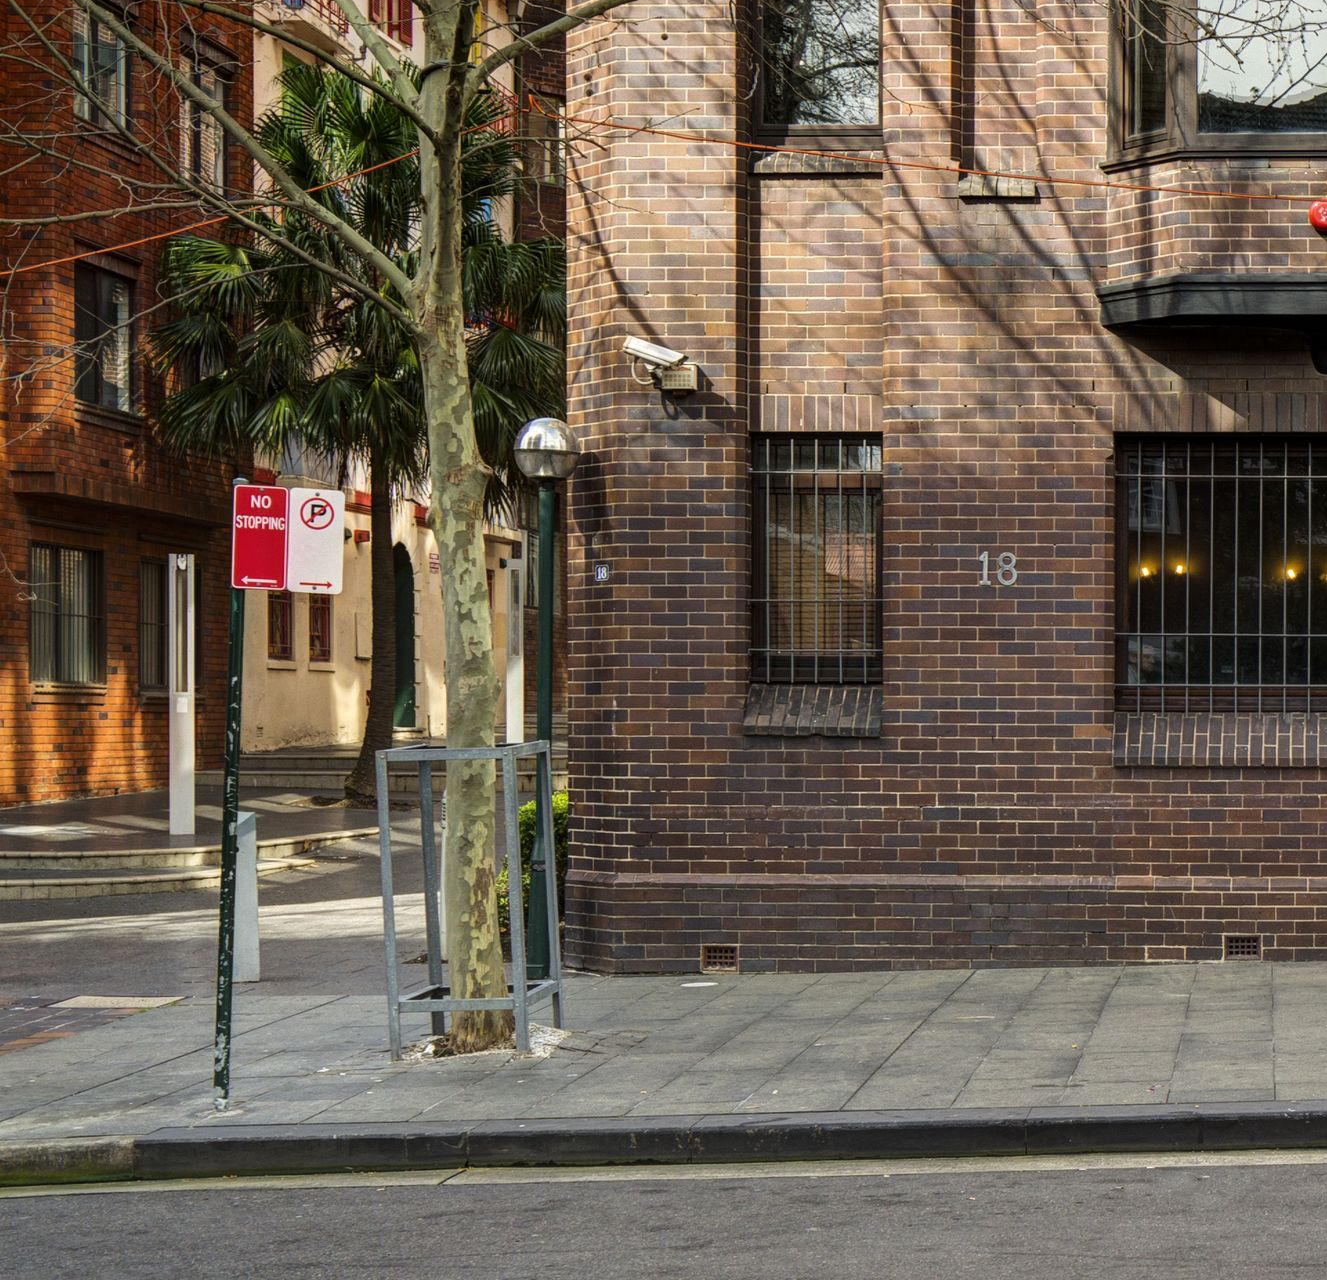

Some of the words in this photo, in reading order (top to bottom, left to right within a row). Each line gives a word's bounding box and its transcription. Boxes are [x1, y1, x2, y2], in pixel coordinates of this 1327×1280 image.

[251, 495, 271, 509] NO
[236, 515, 285, 530] STOPPING
[598, 567, 607, 579] 18
[979, 551, 1017, 585] 18
